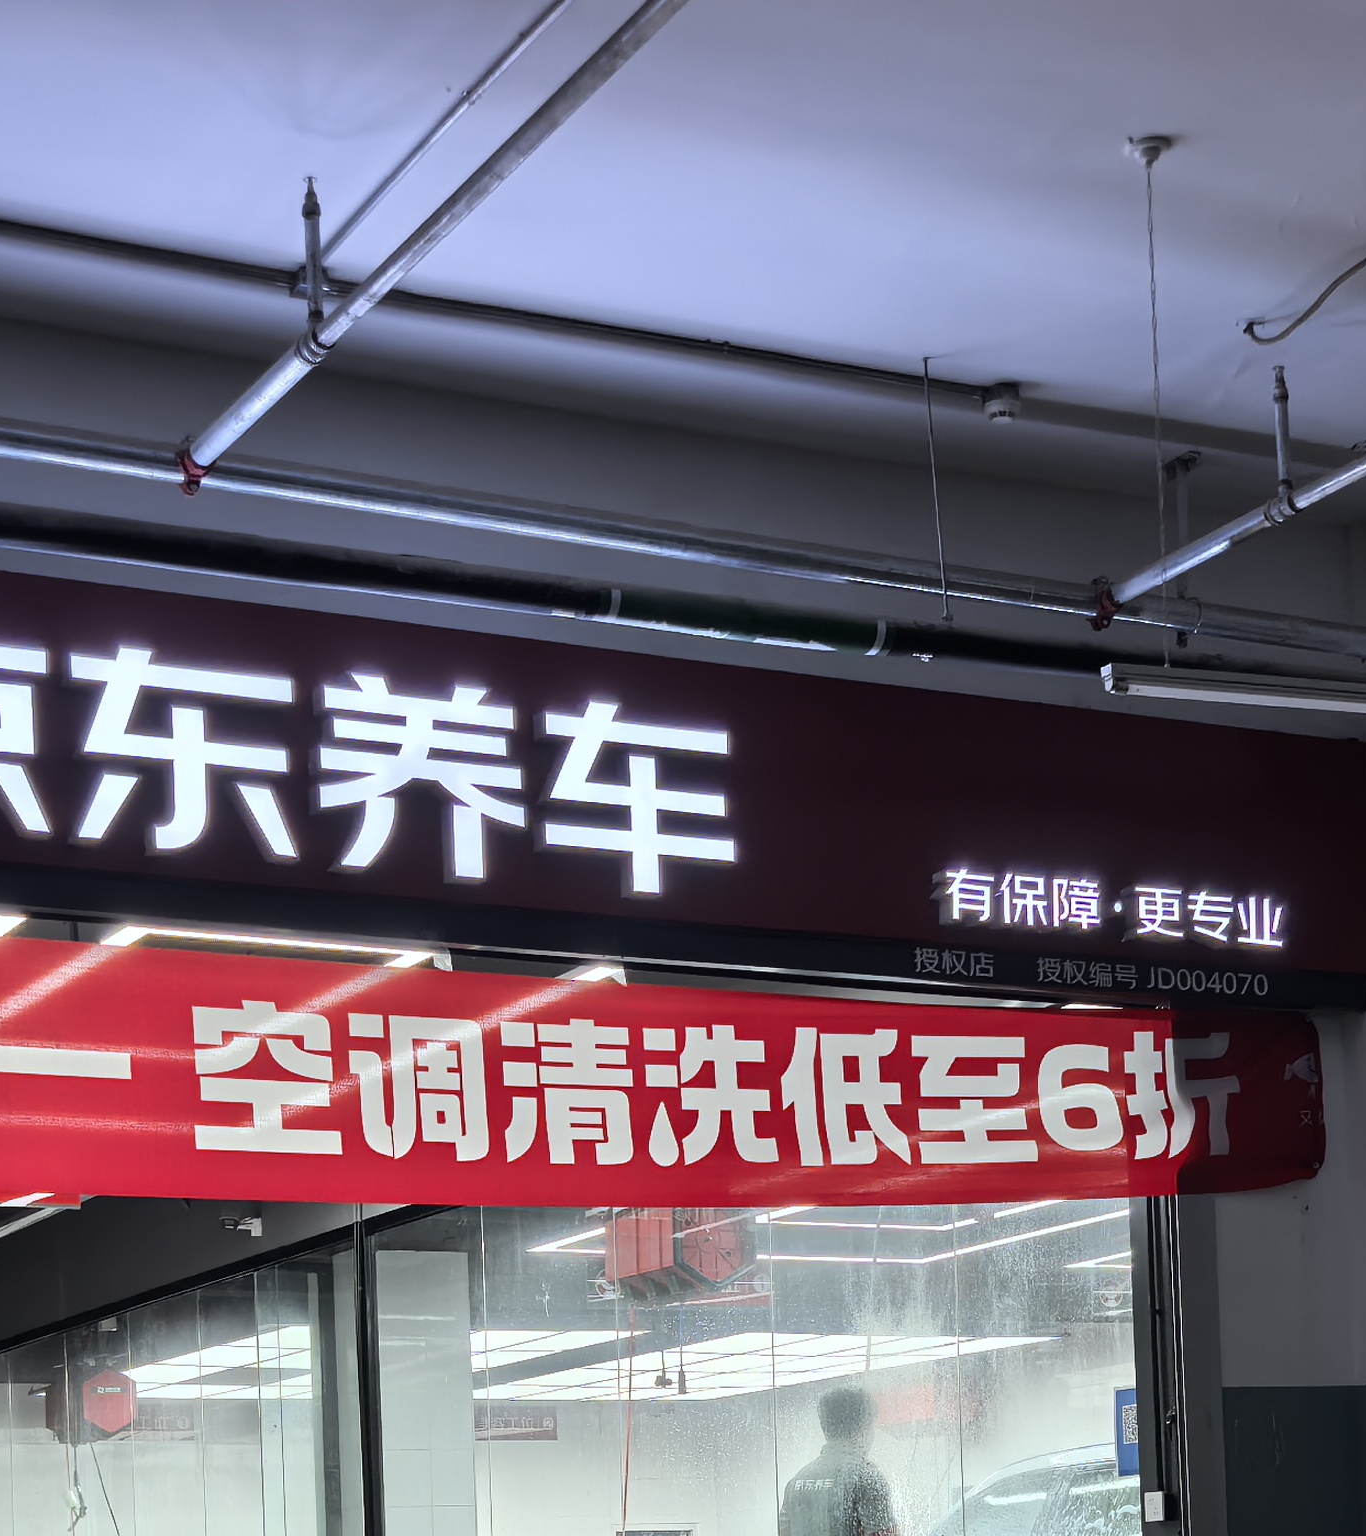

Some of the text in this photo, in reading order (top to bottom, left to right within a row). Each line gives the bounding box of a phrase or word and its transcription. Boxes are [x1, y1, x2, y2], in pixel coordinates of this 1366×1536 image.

[944, 867, 1284, 948] 有保障·更专业
[913, 946, 1269, 996] 授权店 授权编号 JD004070
[191, 1000, 1241, 1168] 空调清洗低至6折
